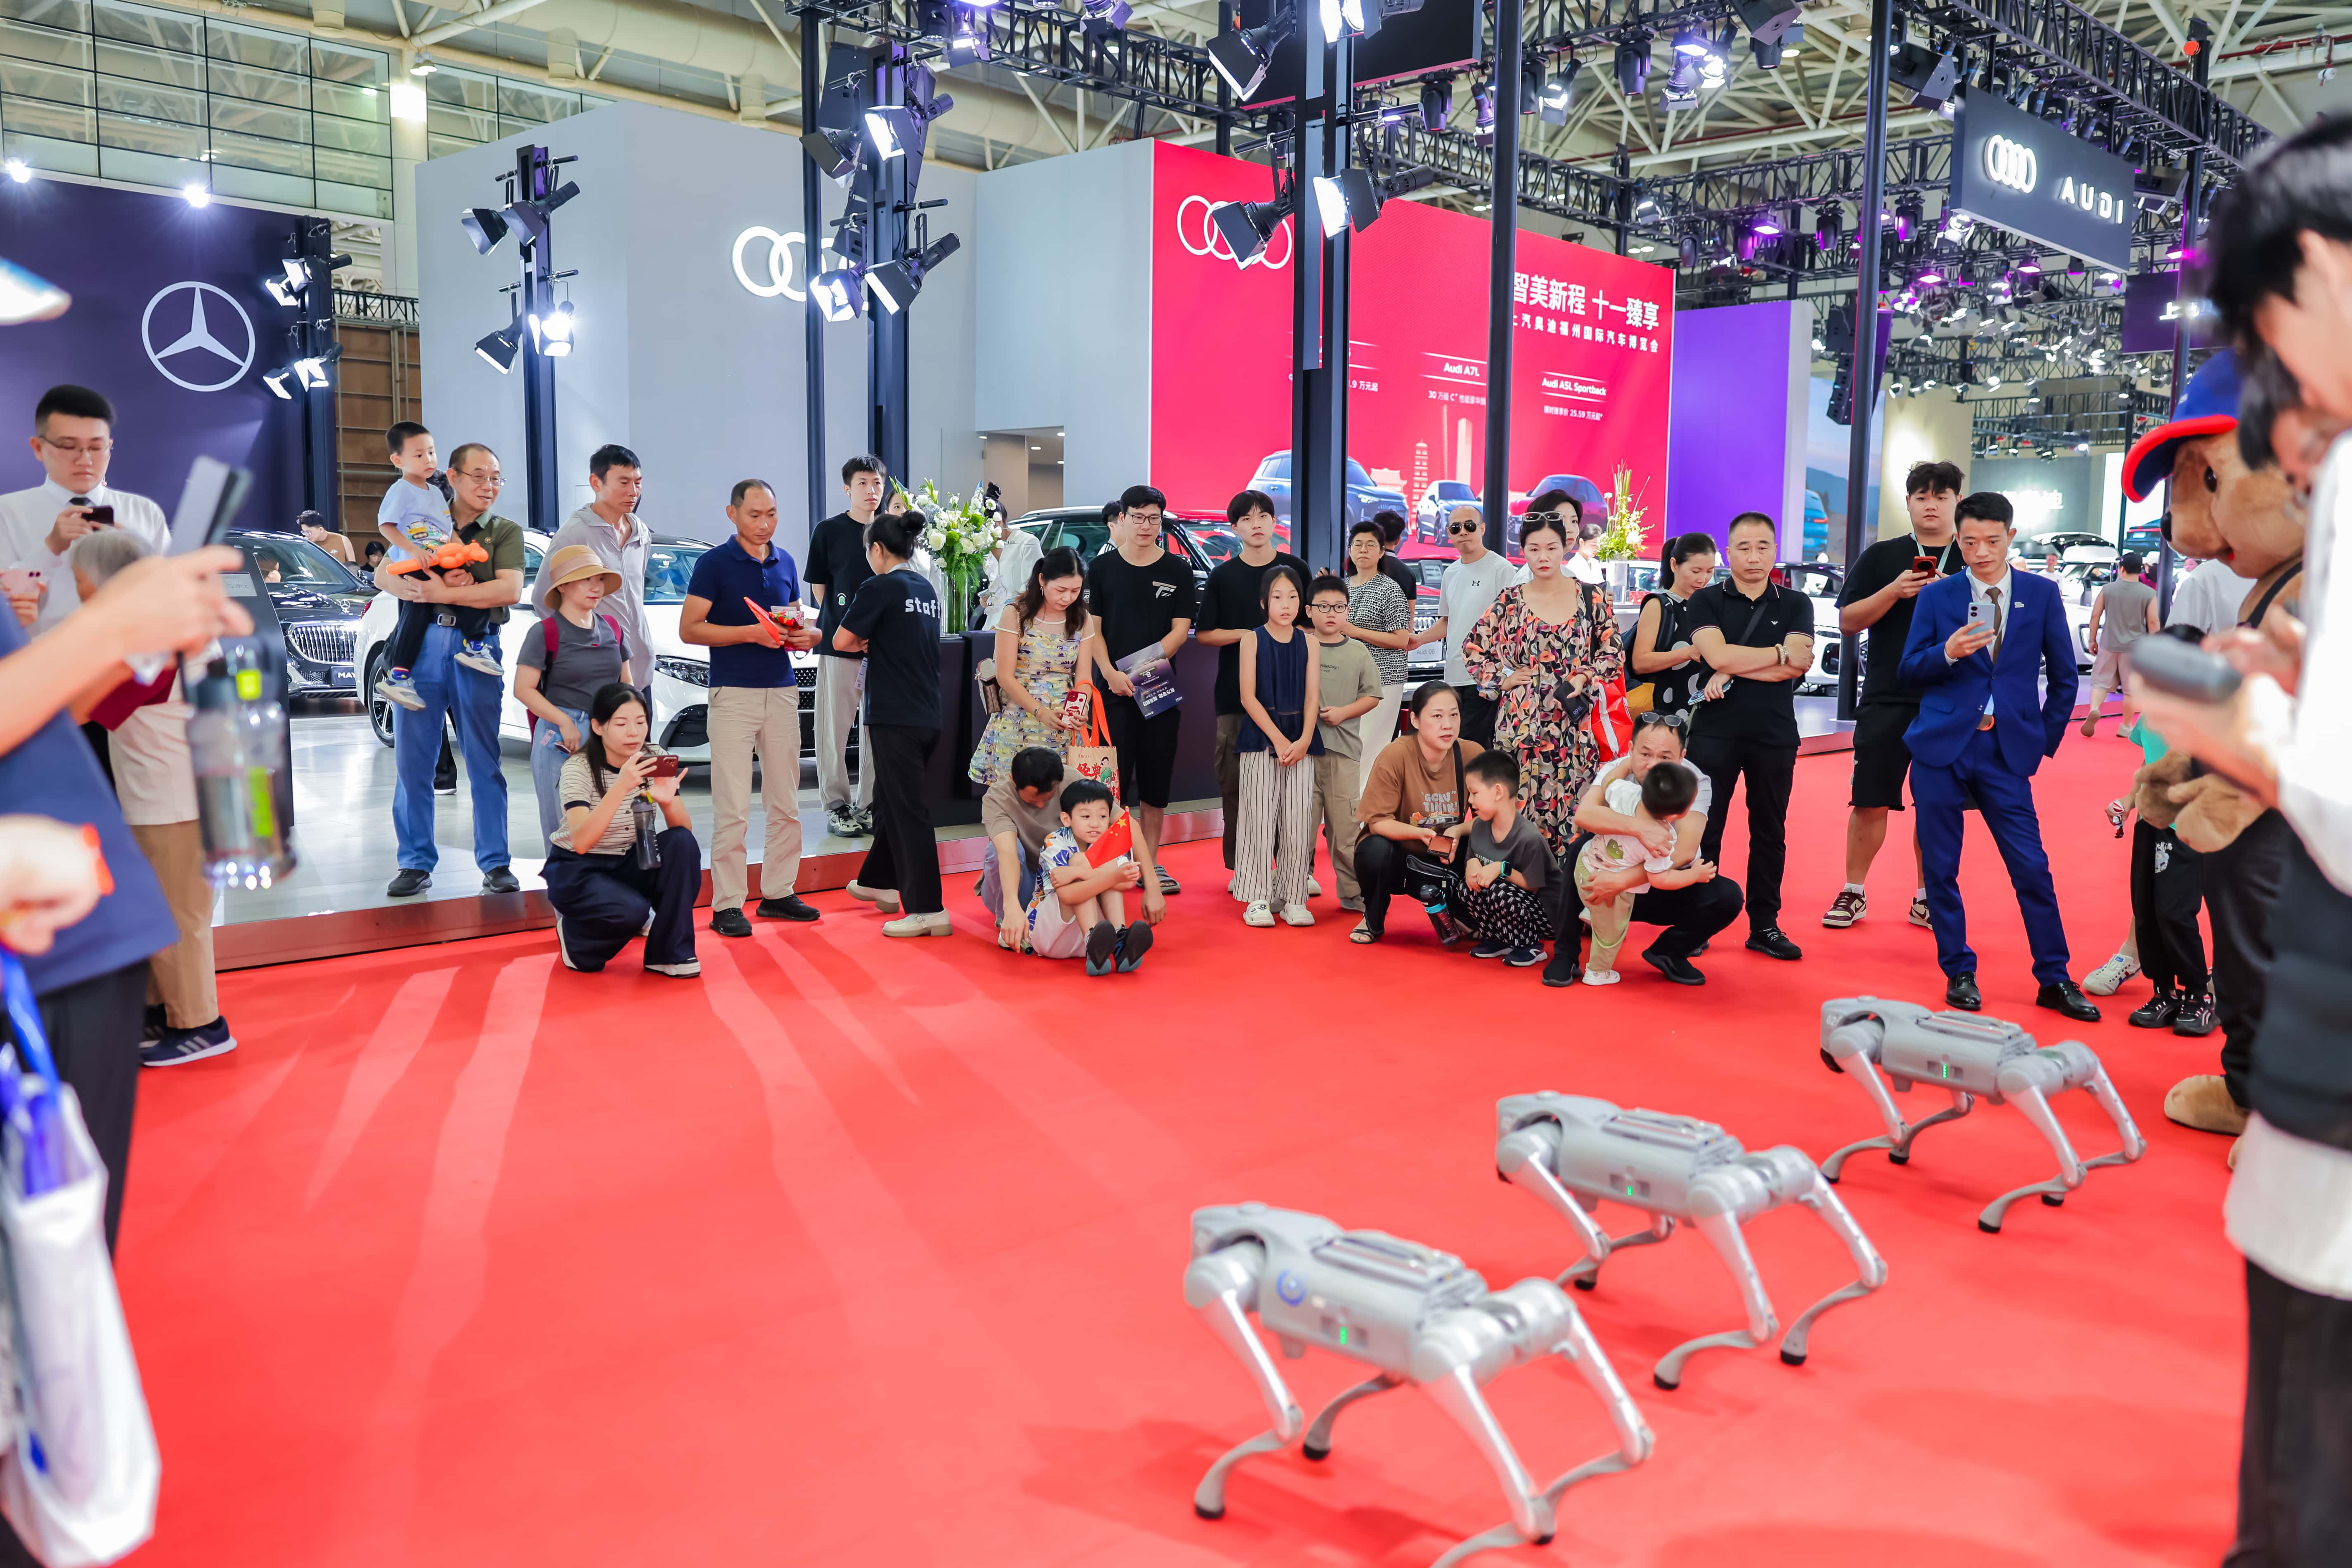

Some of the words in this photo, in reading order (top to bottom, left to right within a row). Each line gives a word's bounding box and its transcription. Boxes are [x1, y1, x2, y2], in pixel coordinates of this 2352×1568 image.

[2059, 176, 2123, 225] AUDI
[1514, 272, 1585, 315] 智美新程
[1592, 290, 1659, 330] 十一臻享
[1443, 362, 1462, 374] Audi
[1463, 365, 1480, 376] A7L
[1349, 379, 1357, 388] .9
[1358, 380, 1378, 392] 万元起
[1542, 378, 1558, 388] Audi
[1574, 382, 1607, 396] Sportback
[1428, 390, 1437, 399] 30
[1570, 409, 1585, 418] 25.59
